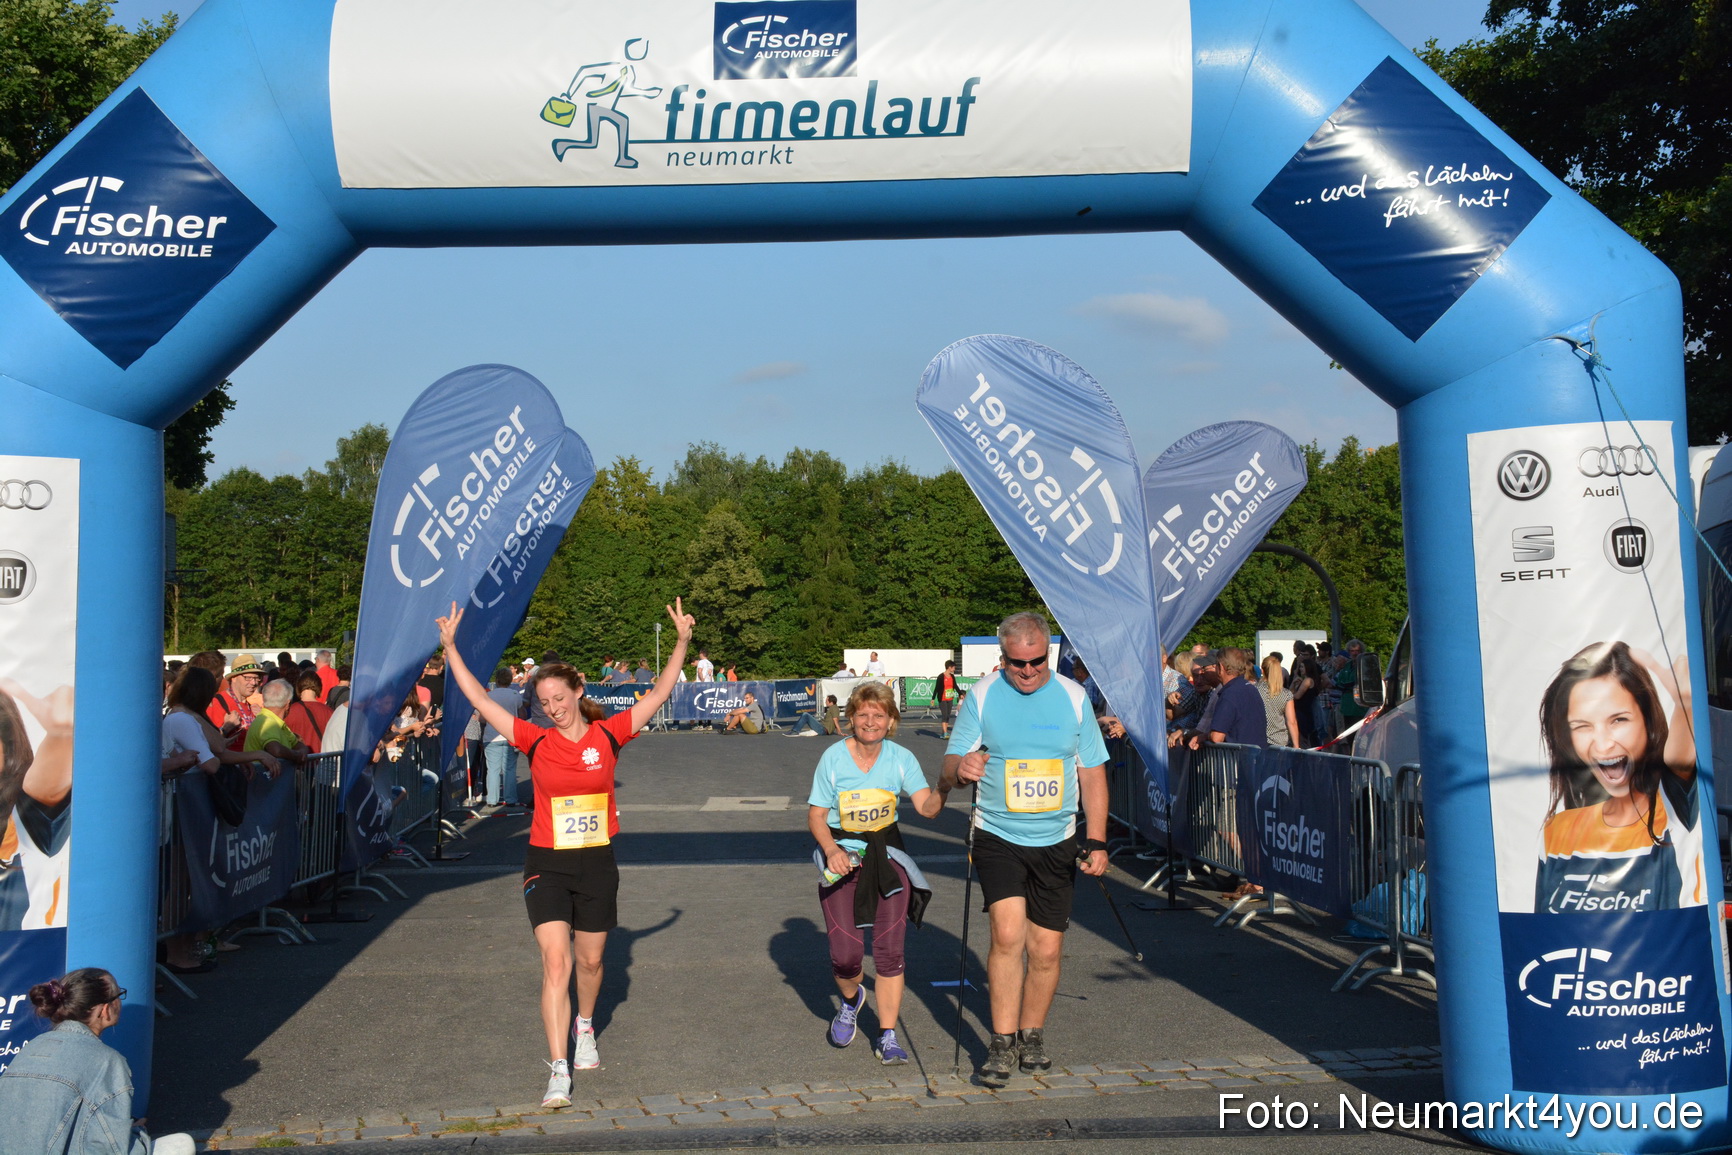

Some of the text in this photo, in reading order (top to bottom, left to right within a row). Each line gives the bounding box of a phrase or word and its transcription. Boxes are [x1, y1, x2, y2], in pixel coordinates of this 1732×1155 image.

[744, 29, 848, 49] Fischer
[754, 48, 839, 60] AUTOMOBILE
[665, 76, 981, 142] firmenlauf
[666, 145, 794, 167] neumarkt
[1321, 174, 1367, 202] und
[1375, 171, 1419, 190] das
[1424, 163, 1513, 185] Lächeln
[51, 205, 227, 239] Fischer
[1383, 188, 1509, 228] fährt mit!
[64, 241, 213, 258] AUTOMOBILE
[417, 405, 526, 561] Fischer
[1582, 486, 1620, 498] Audi
[456, 436, 537, 560] AUTOMOBILE
[486, 461, 563, 586] Fischer
[512, 476, 573, 584] AUTOMOBILE
[1161, 451, 1267, 582] Fischer
[1196, 477, 1278, 581] AUTOMOBILE
[1616, 534, 1644, 559] FIAT
[1500, 568, 1572, 582] SEAT
[910, 682, 934, 696] AOK
[1012, 780, 1059, 798] 1506
[565, 815, 599, 834] 255
[847, 805, 890, 823] 1505
[1264, 810, 1326, 859] Fischer
[225, 825, 277, 874] Fischer
[232, 866, 271, 898] AUTOMOBILE
[1272, 856, 1324, 885] AUTOMOBILE
[1559, 889, 1651, 911] Fischer
[1552, 972, 1692, 1000] Fischer
[1566, 1001, 1686, 1017] AUTOMOBILE
[1596, 1033, 1627, 1050] und
[1631, 1029, 1660, 1045] das
[1663, 1023, 1713, 1043] Lächeln
[1638, 1038, 1711, 1069] fährt mit!
